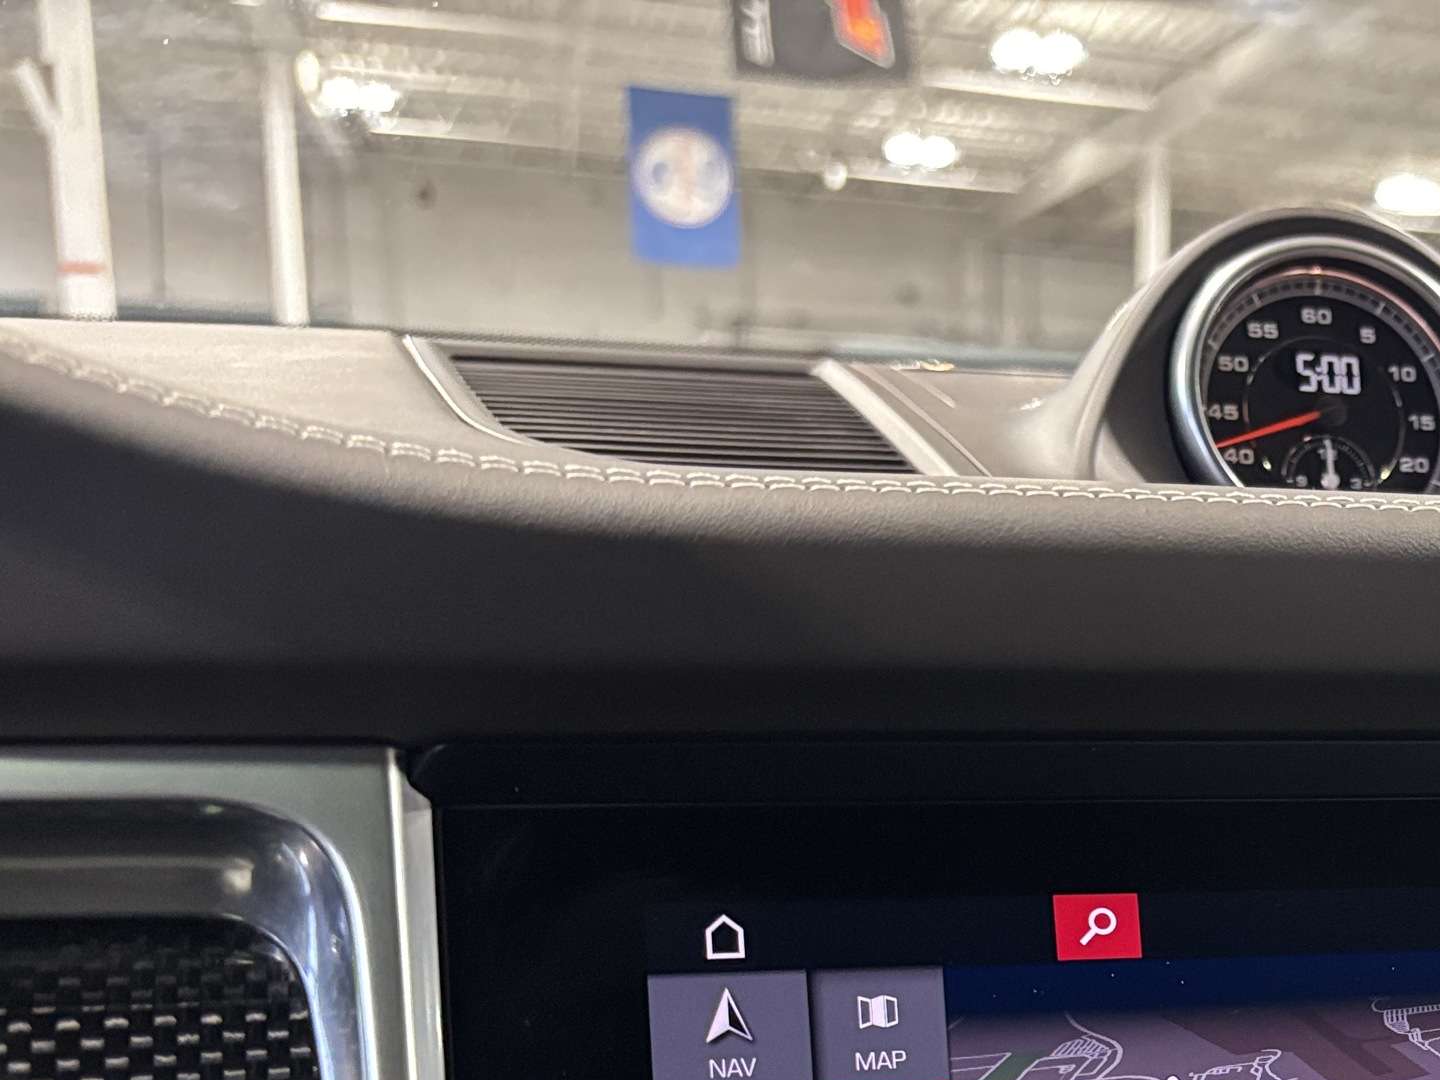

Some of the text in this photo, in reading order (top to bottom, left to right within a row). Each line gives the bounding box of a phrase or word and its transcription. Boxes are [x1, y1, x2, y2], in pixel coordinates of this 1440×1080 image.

[1301, 307, 1332, 323] 60
[1247, 322, 1279, 339] 55
[1359, 326, 1376, 344] 5
[1218, 355, 1249, 372] 50
[1388, 366, 1417, 383] 10
[1208, 403, 1240, 420] 45
[1408, 415, 1436, 431] 15
[1224, 449, 1255, 465] 40
[1400, 457, 1430, 473] 20
[708, 1057, 758, 1080] NAV
[855, 1050, 908, 1071] MAP
